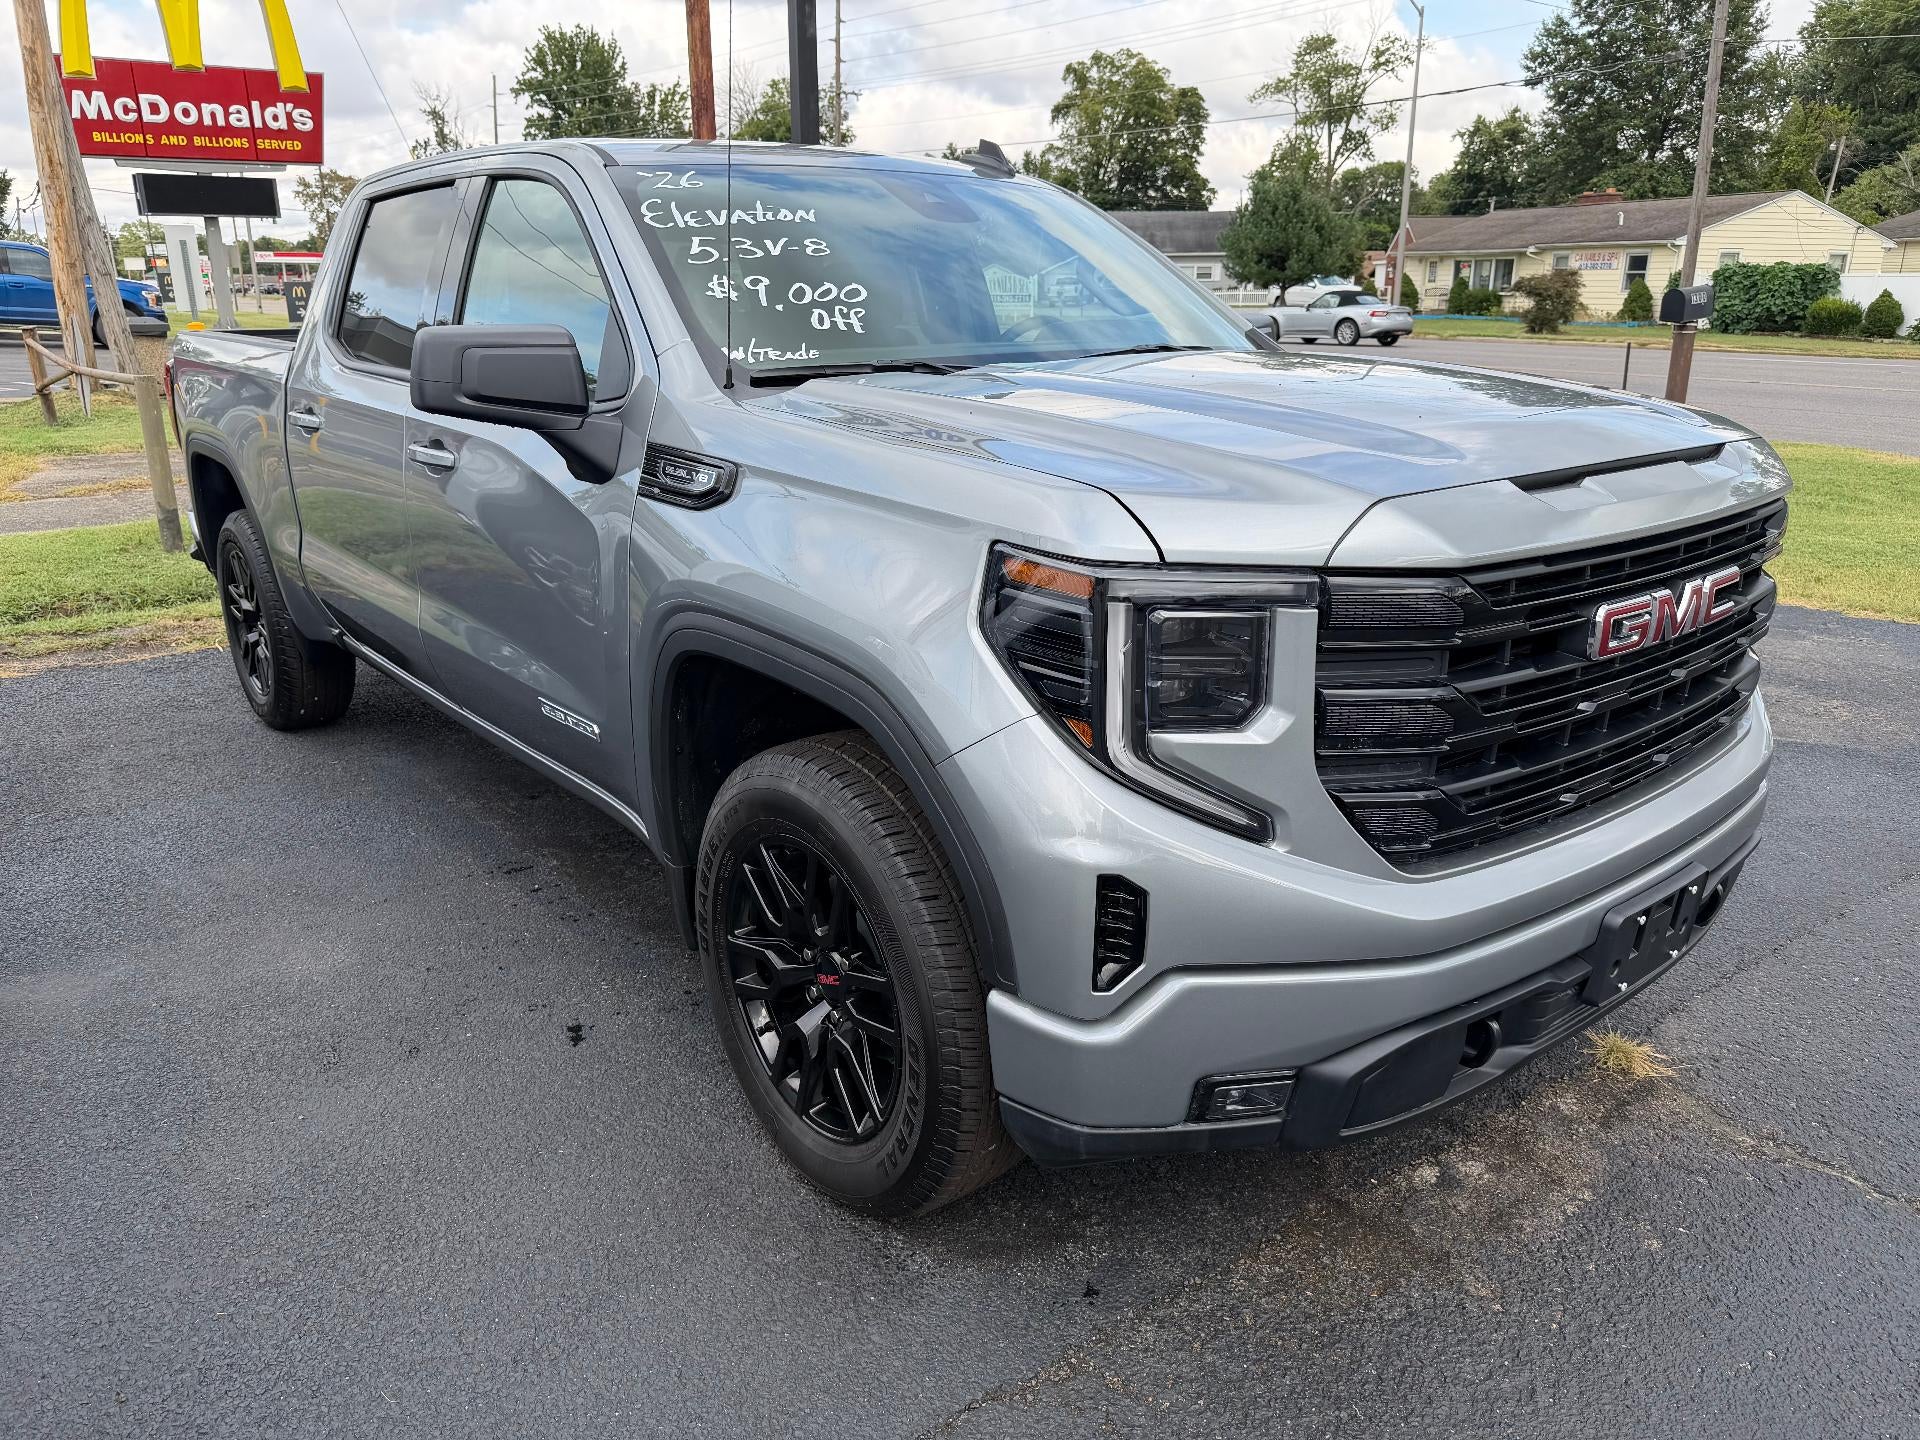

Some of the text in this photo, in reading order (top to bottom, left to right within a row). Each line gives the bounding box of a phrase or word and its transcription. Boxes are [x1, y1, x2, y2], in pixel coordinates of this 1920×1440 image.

[71, 90, 314, 132] McDonald's
[92, 131, 302, 151] BILLIONS AND BILLIONS SERVED
[1587, 565, 1741, 661] GMC
